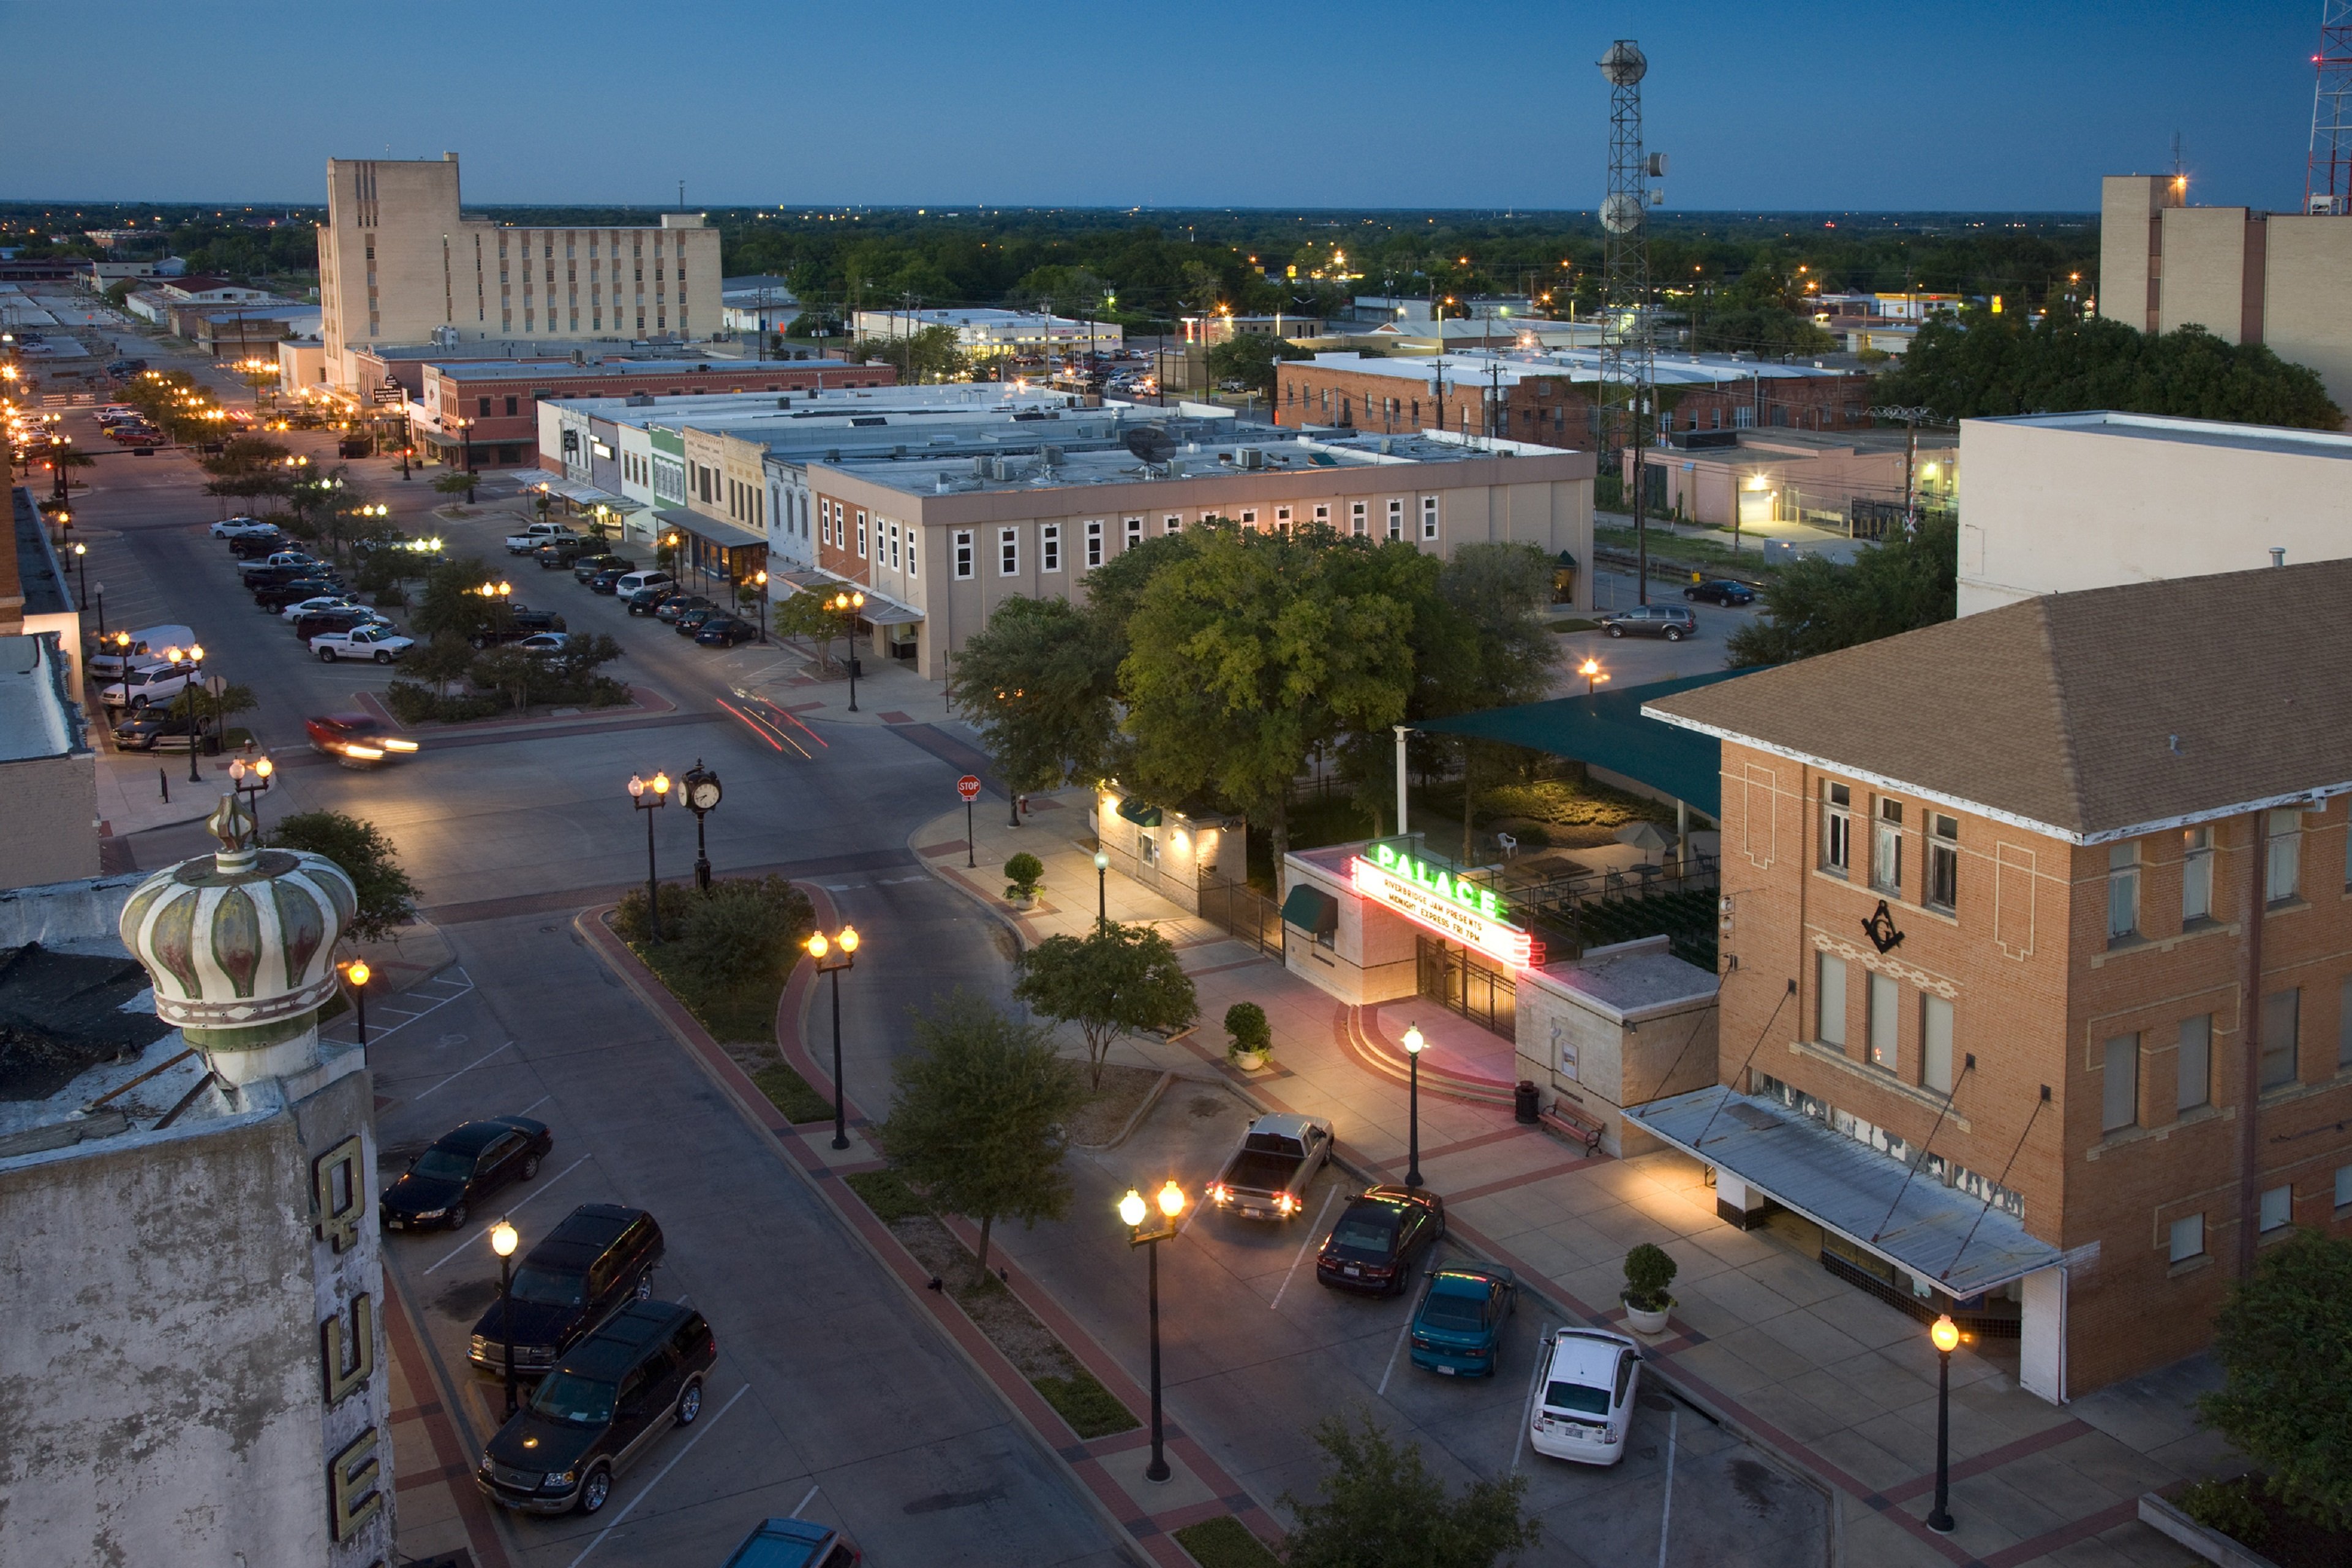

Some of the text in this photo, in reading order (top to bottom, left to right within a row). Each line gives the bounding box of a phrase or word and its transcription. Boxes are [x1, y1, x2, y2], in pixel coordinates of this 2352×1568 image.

[959, 782, 979, 791] STOP
[1378, 843, 1496, 920] PALACE
[1389, 893, 1480, 943] MIDNIGHT EXPRESS FRI 7PM
[1430, 901, 1444, 913] JAM
[1446, 908, 1482, 931] PRESENTS
[312, 1134, 384, 1568] QUE
